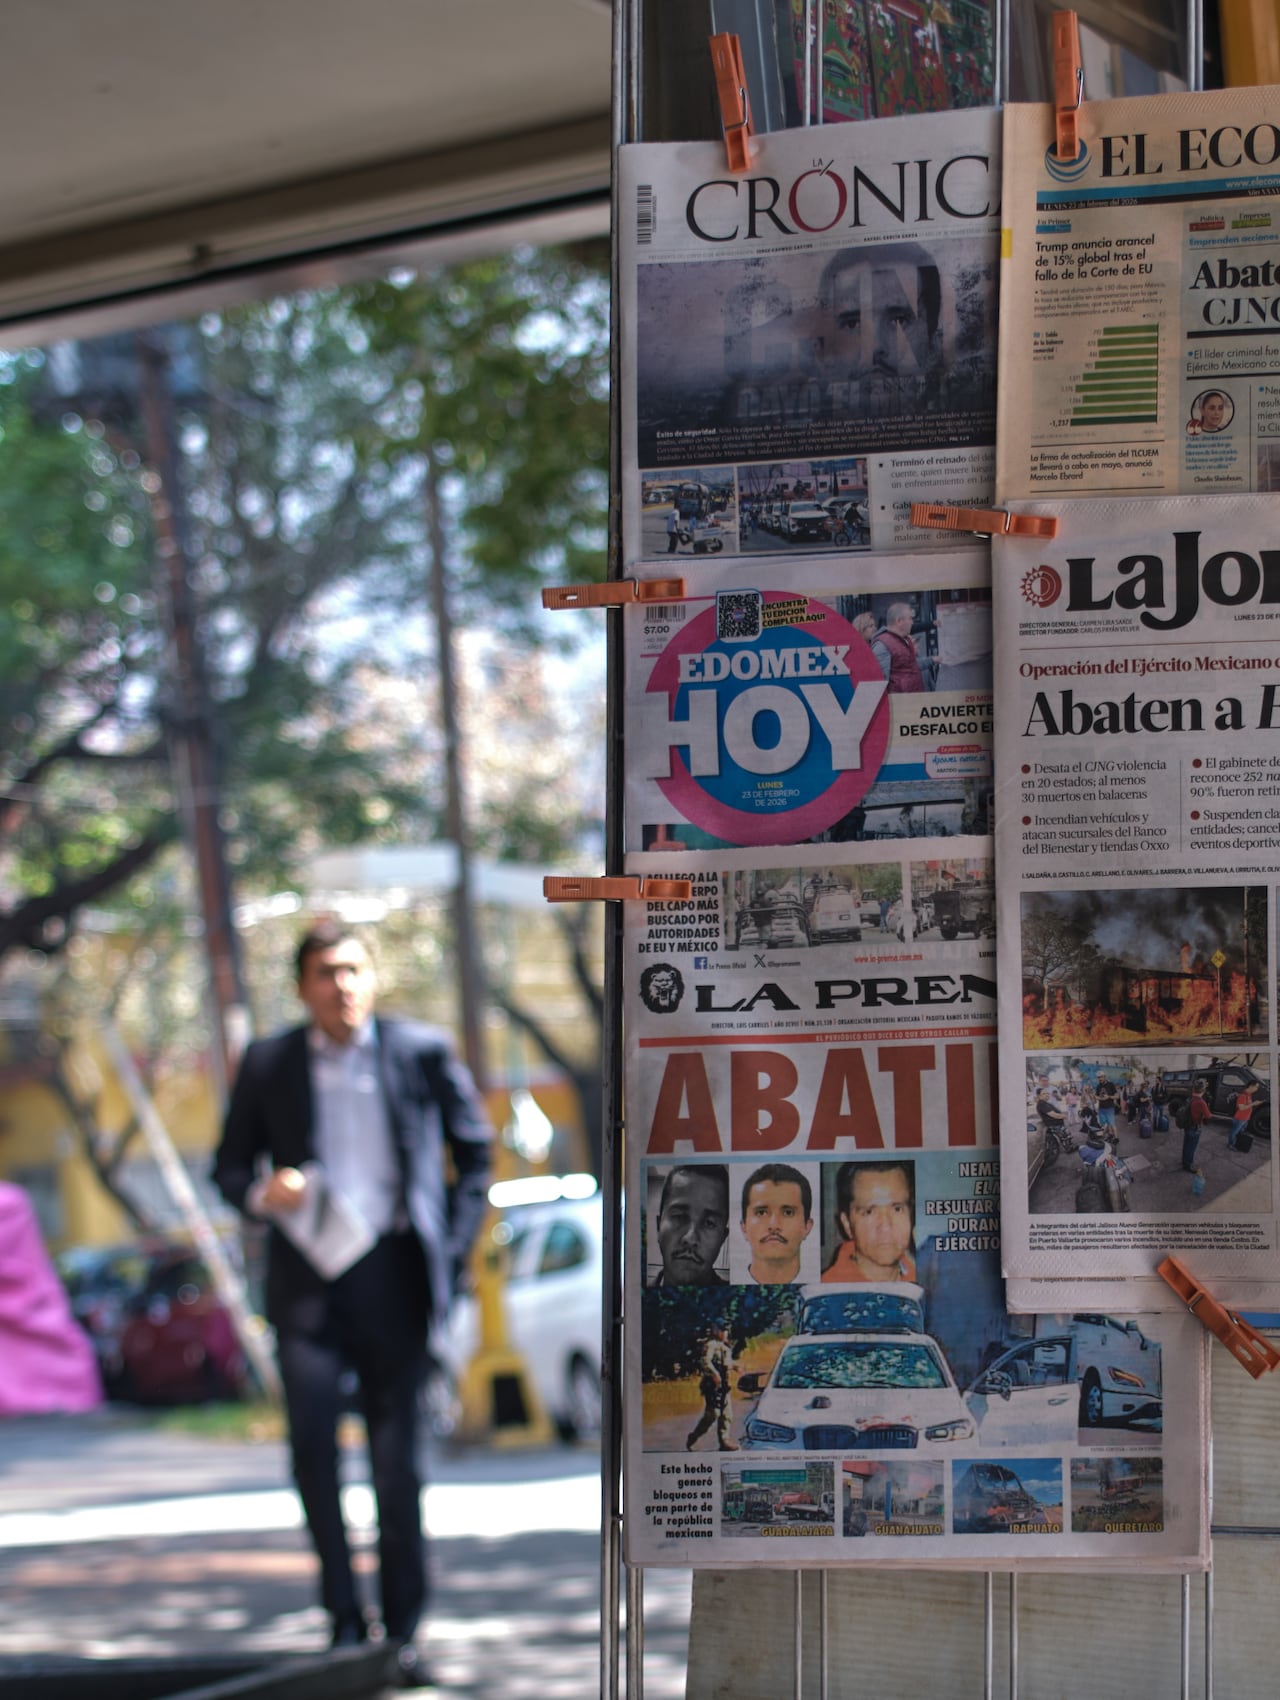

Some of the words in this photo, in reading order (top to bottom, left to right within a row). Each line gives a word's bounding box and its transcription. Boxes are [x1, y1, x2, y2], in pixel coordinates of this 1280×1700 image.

[812, 157, 824, 167] LA
[1099, 134, 1163, 178] EL
[685, 155, 1000, 242] CRÓNIC
[1036, 242, 1068, 253] Trump
[1072, 238, 1112, 250] anuncia
[1116, 235, 1155, 247] arancel
[1035, 257, 1049, 267] de
[1054, 254, 1074, 265] 15%
[1077, 251, 1110, 267] global
[1114, 251, 1133, 260] tras
[1136, 249, 1145, 260] el
[1194, 350, 1203, 360] El
[1204, 349, 1223, 359] líder
[1227, 347, 1263, 358] criminal
[1265, 346, 1279, 356] fue
[927, 457, 933, 465] el
[936, 456, 966, 464] reinado
[1066, 554, 1167, 612] La
[645, 626, 669, 634] $7.00
[679, 645, 850, 683] EDOMEX
[1020, 660, 1101, 679] Operación
[1104, 660, 1129, 674] del
[1132, 657, 1191, 676] Ejército
[1195, 656, 1272, 672] Mexicano
[1022, 689, 1205, 736] Abaten
[1215, 697, 1246, 729] a
[646, 680, 889, 781] HOY
[900, 722, 977, 737] DESFALCO
[1034, 763, 1068, 775] Desata
[1072, 762, 1081, 772] el
[1085, 760, 1115, 772] CJNG
[1117, 759, 1166, 771] violencia
[647, 915, 696, 925] BUSCADO
[699, 914, 719, 924] POR
[648, 928, 719, 939] AUTORIDADES
[639, 943, 653, 953] DE
[654, 943, 666, 952] EU
[669, 943, 675, 952] Y
[677, 940, 718, 952] MÉXICO
[695, 983, 800, 1013] LA
[646, 1043, 1000, 1153] ABATI
[660, 1465, 680, 1474] Este
[684, 1465, 712, 1474] hecho
[761, 1526, 834, 1536] GUADALAJARA
[874, 1525, 942, 1536] GUANAJUATO
[1009, 1523, 1060, 1534] IRAPUATO
